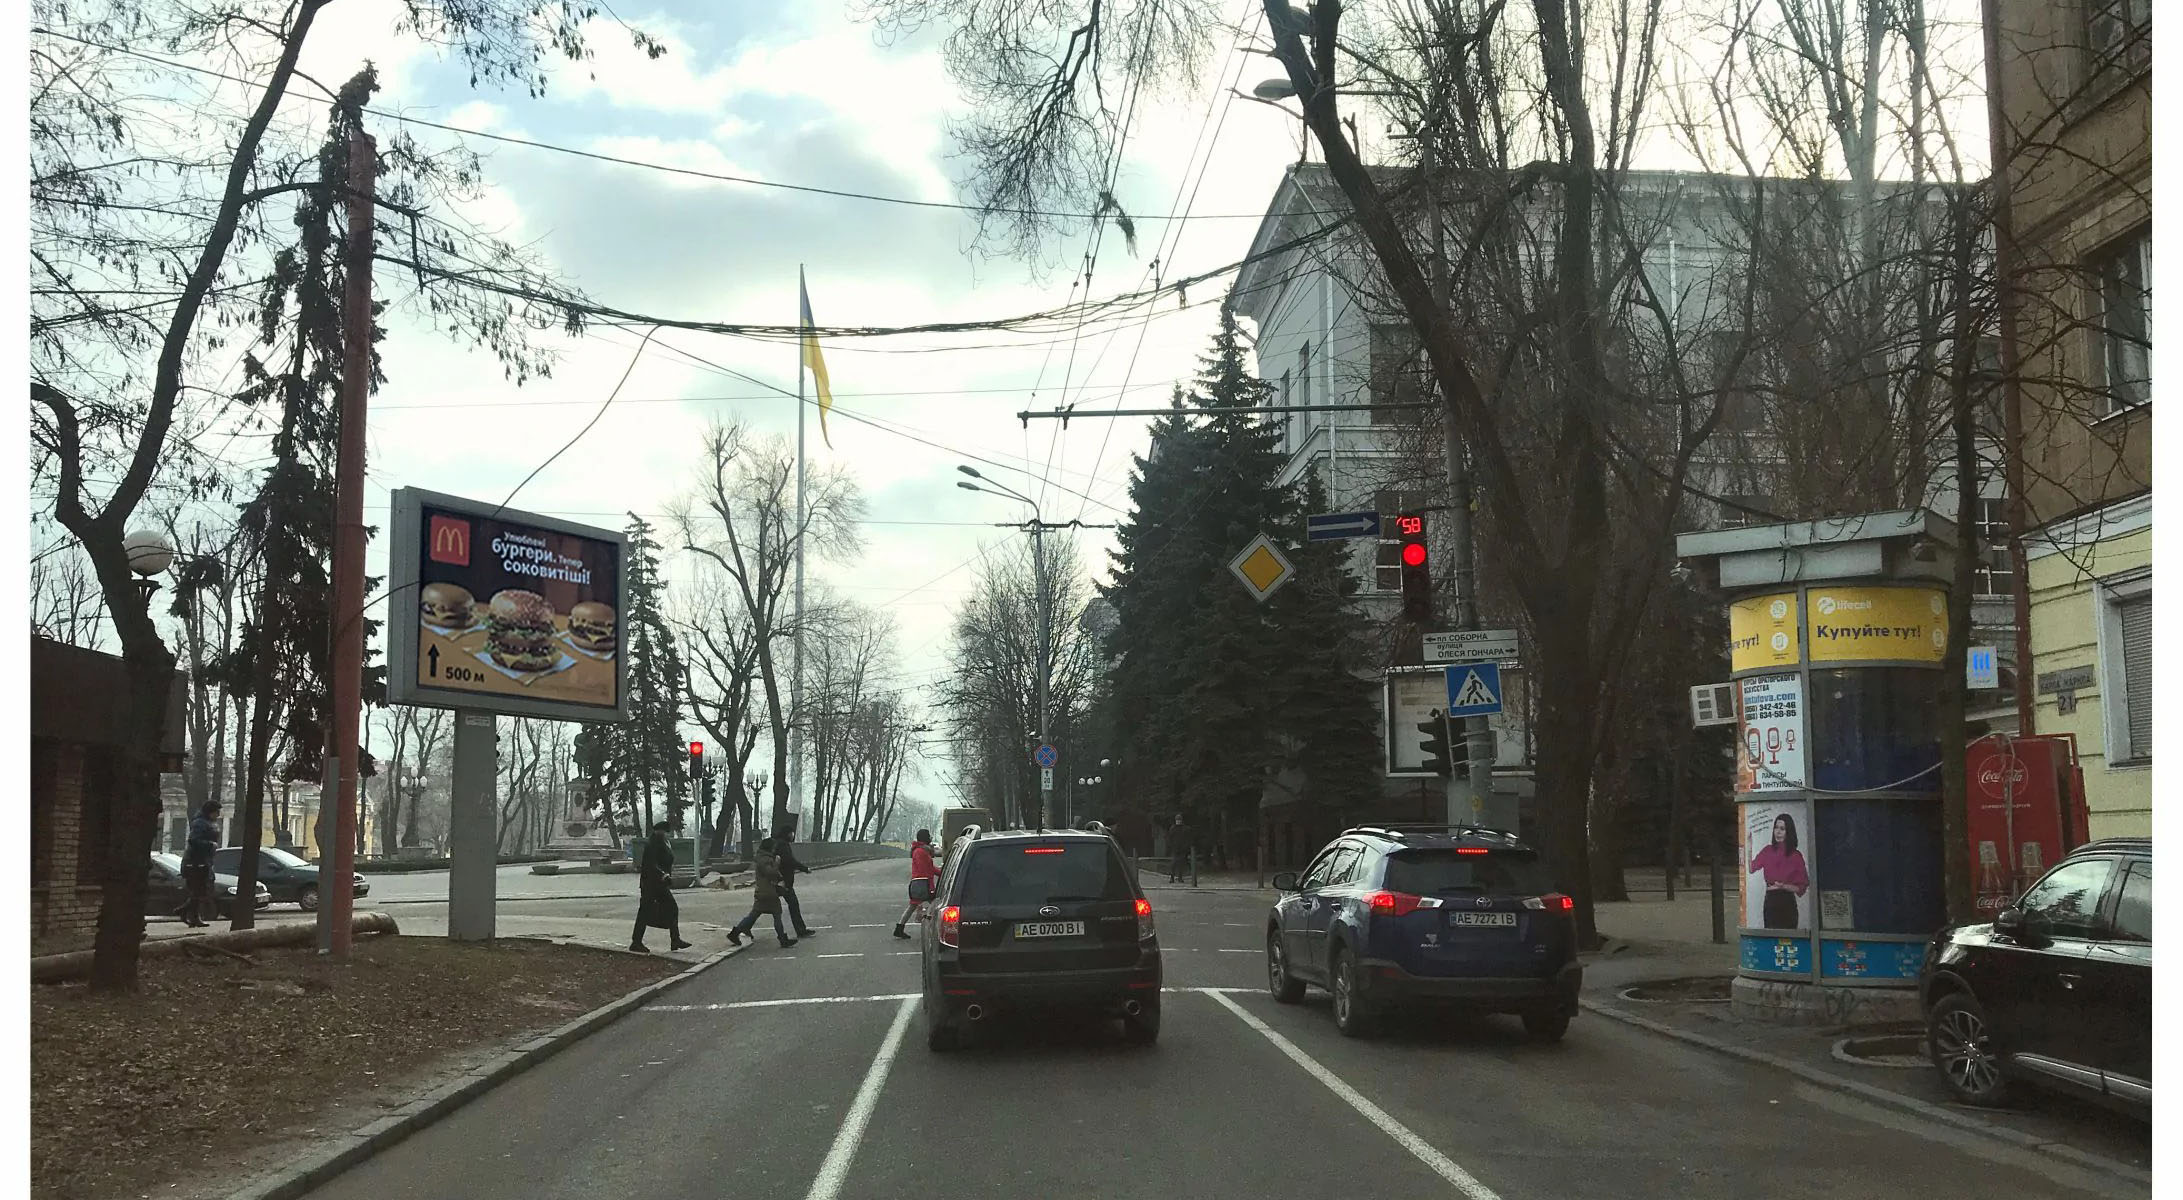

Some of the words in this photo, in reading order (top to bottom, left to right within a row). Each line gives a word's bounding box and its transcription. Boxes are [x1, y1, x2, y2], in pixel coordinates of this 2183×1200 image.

[1403, 517, 1421, 534] 58
[504, 531, 546, 547] Улюблені
[492, 538, 557, 563] бургери.
[558, 554, 583, 569] Тепер
[503, 559, 591, 585] соковитіші!
[1837, 600, 1872, 610] lifecell
[1449, 633, 1488, 642] СОБОРНА
[1817, 624, 1890, 640] Купуйте
[1894, 625, 1921, 639] тут!
[1741, 633, 1759, 650] тут!
[1437, 650, 1466, 658] ОЛЕСЯ
[1467, 648, 1504, 657] ГОНЧАРА
[446, 666, 471, 681] 500
[1457, 913, 1472, 924] AE
[1474, 913, 1497, 924] 7272
[1021, 924, 1037, 936] AE
[1040, 923, 1064, 935] 0700
